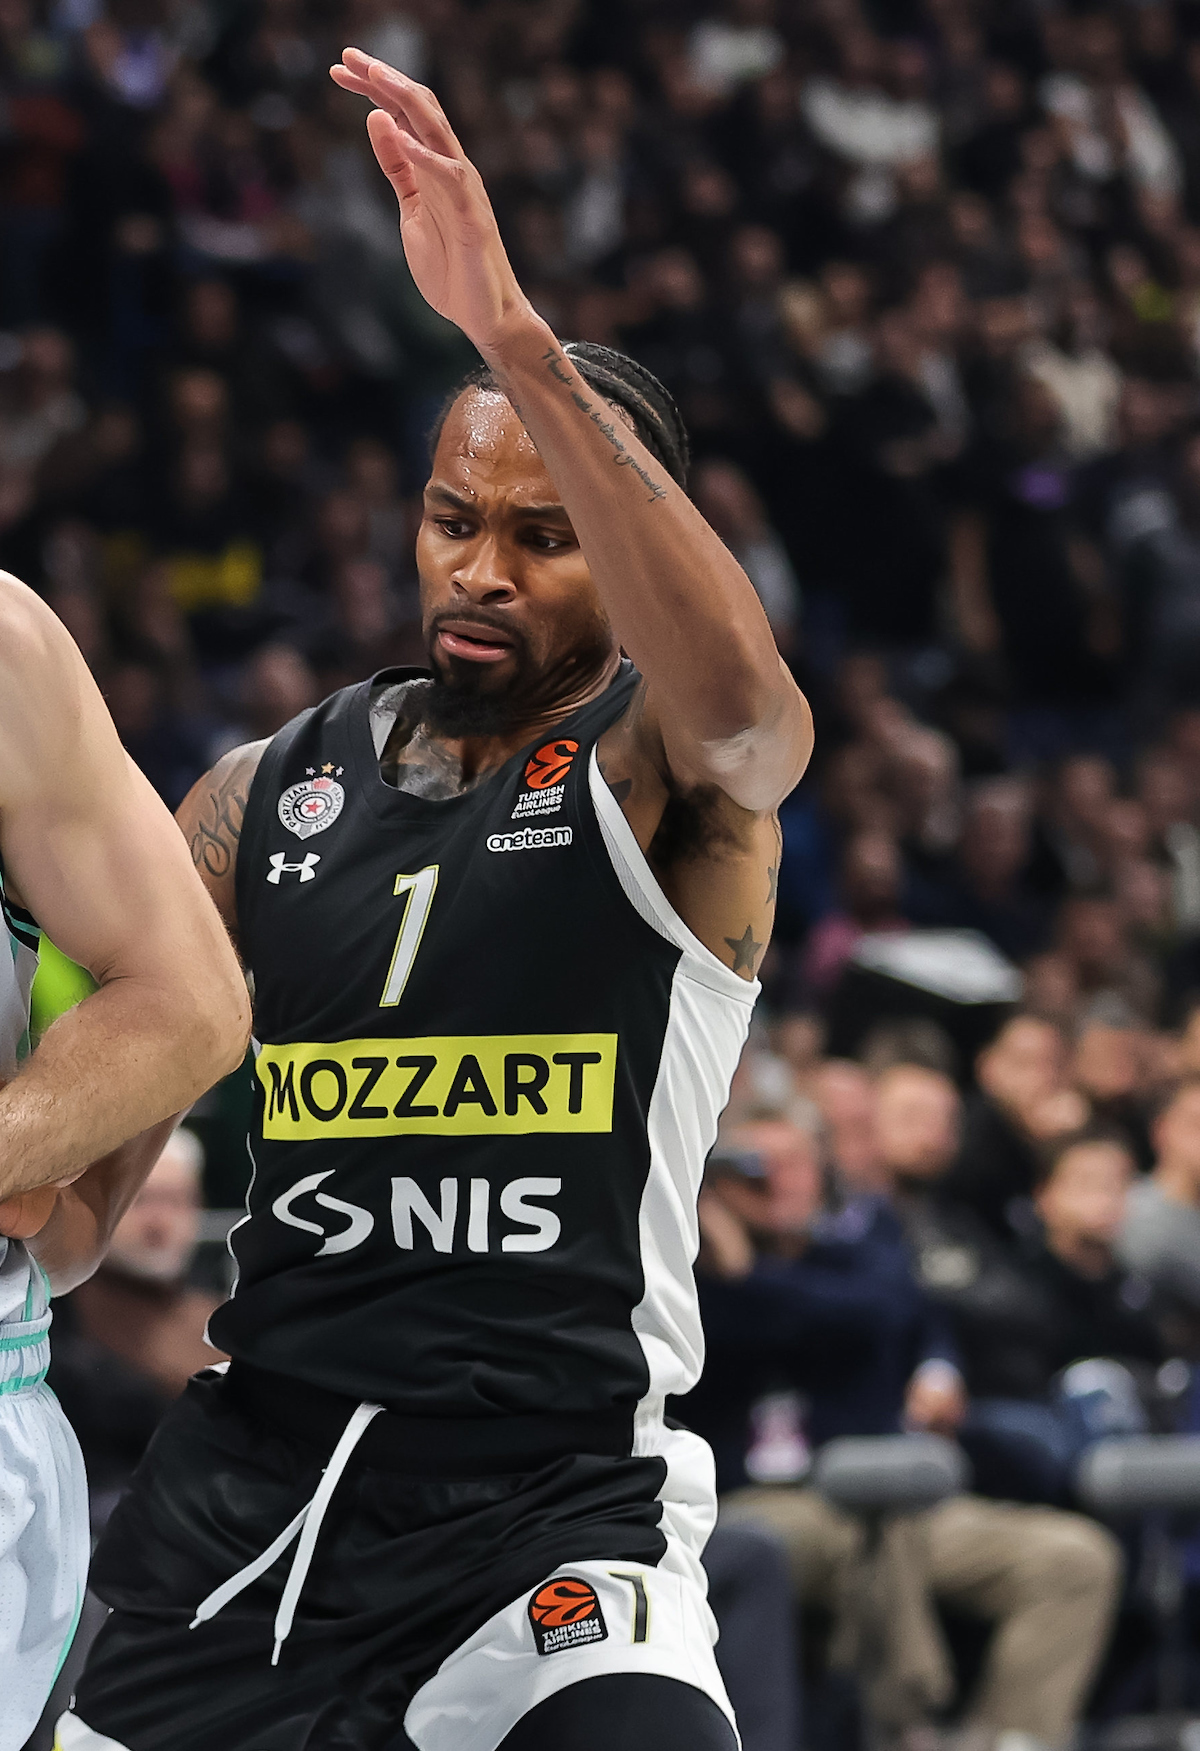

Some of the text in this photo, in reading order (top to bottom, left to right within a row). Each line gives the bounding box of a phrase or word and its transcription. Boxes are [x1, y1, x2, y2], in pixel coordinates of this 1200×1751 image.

[514, 794, 563, 812] AIRLINES
[518, 784, 565, 802] TURKISH
[511, 805, 561, 819] EuroLeague
[488, 828, 572, 851] oneteam
[379, 865, 439, 1008] 1
[267, 1052, 602, 1122] MOZZART
[391, 1177, 562, 1253] NIS
[542, 1617, 600, 1640] TURKISH
[544, 1626, 602, 1646] AIRLINES
